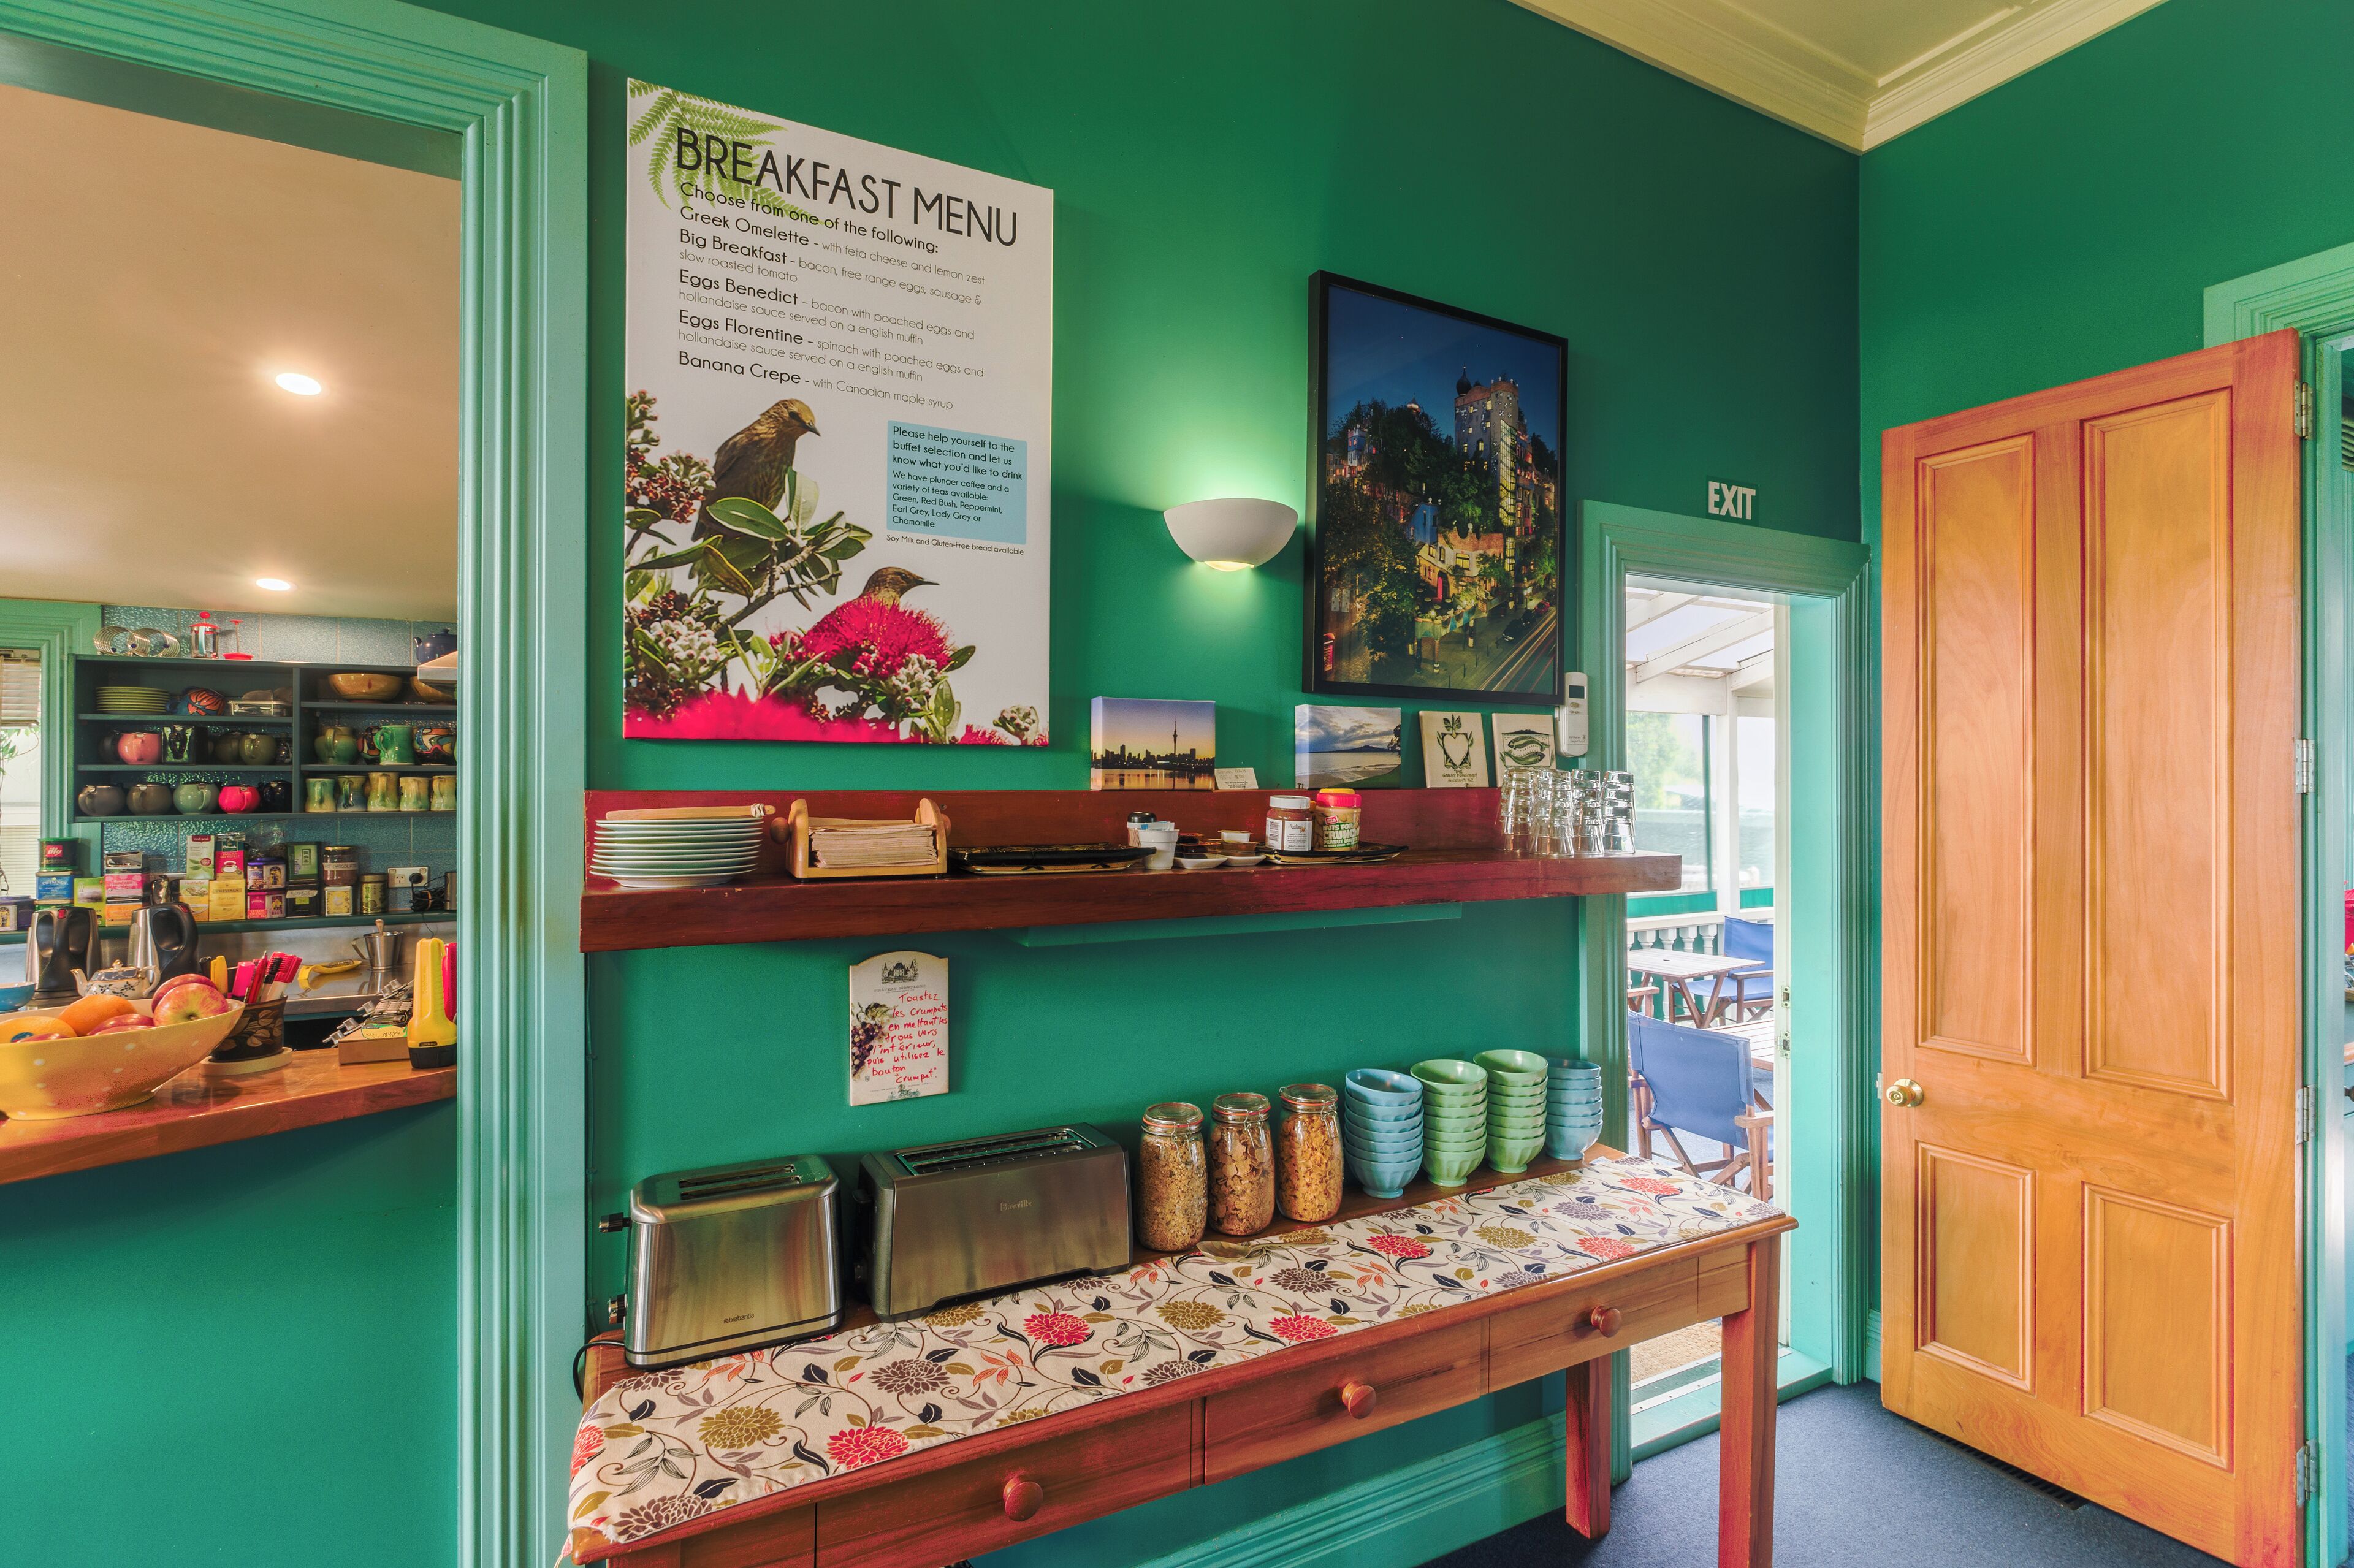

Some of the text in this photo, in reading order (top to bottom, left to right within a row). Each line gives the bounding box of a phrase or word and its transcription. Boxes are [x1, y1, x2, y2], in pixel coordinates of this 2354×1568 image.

[676, 125, 1017, 247] BREAKFAST MENU
[680, 181, 939, 254] Choose from one of the following:
[680, 205, 985, 285] Greek Omelette with feta cheese and lemon zest
[679, 248, 798, 283] slow roasted tomato
[680, 228, 982, 305] Big Breakfast bacon, free range eggs, sausage &
[679, 268, 975, 340] Eggs Benedict bacon with poached eggs and
[679, 287, 923, 345] hollandaise sauce served on a english muffin
[679, 308, 984, 378] Eggs Florentine spinach with poached eggs and
[678, 328, 923, 382] hollandaise sauce served on a english muffin
[679, 350, 953, 411] Banana Crepe with Canadian maple syrup
[893, 425, 1015, 453] Please help yourself to the
[893, 439, 921, 453] buffet
[923, 445, 966, 459] selection
[968, 452, 987, 462] and
[989, 453, 1001, 464] let
[893, 454, 917, 466] know
[918, 458, 942, 470] what
[972, 464, 988, 476] like
[989, 468, 999, 478] to
[1001, 469, 1023, 481] drink
[892, 470, 906, 479] We
[907, 471, 928, 482] have
[929, 475, 959, 487] plunger
[960, 480, 986, 490] coffee
[986, 484, 1002, 492] and
[892, 483, 920, 493] variety
[931, 487, 949, 496] teas
[950, 490, 989, 501] available:
[892, 492, 1003, 514] Green, Red Bush, Peppermint,
[1708, 481, 1756, 520] EXIT
[891, 515, 937, 528] Chamomile.
[892, 503, 908, 514] Earl
[909, 506, 930, 517] Grey,
[931, 508, 951, 520] Lady
[952, 511, 972, 522] Grey
[886, 533, 900, 544] Soy
[901, 535, 915, 544] Milk
[931, 538, 970, 550] Gluten-Free
[971, 542, 992, 552] bread
[993, 546, 1025, 555] available
[47, 847, 63, 856] illy
[899, 990, 940, 1003] Toastez
[892, 1008, 905, 1018] les
[939, 1016, 948, 1025] les
[885, 1033, 913, 1043] trous
[867, 1057, 884, 1068] puis
[894, 1052, 929, 1062] utilisez
[872, 1065, 905, 1076] bouton
[729, 1313, 755, 1323] brabantia
